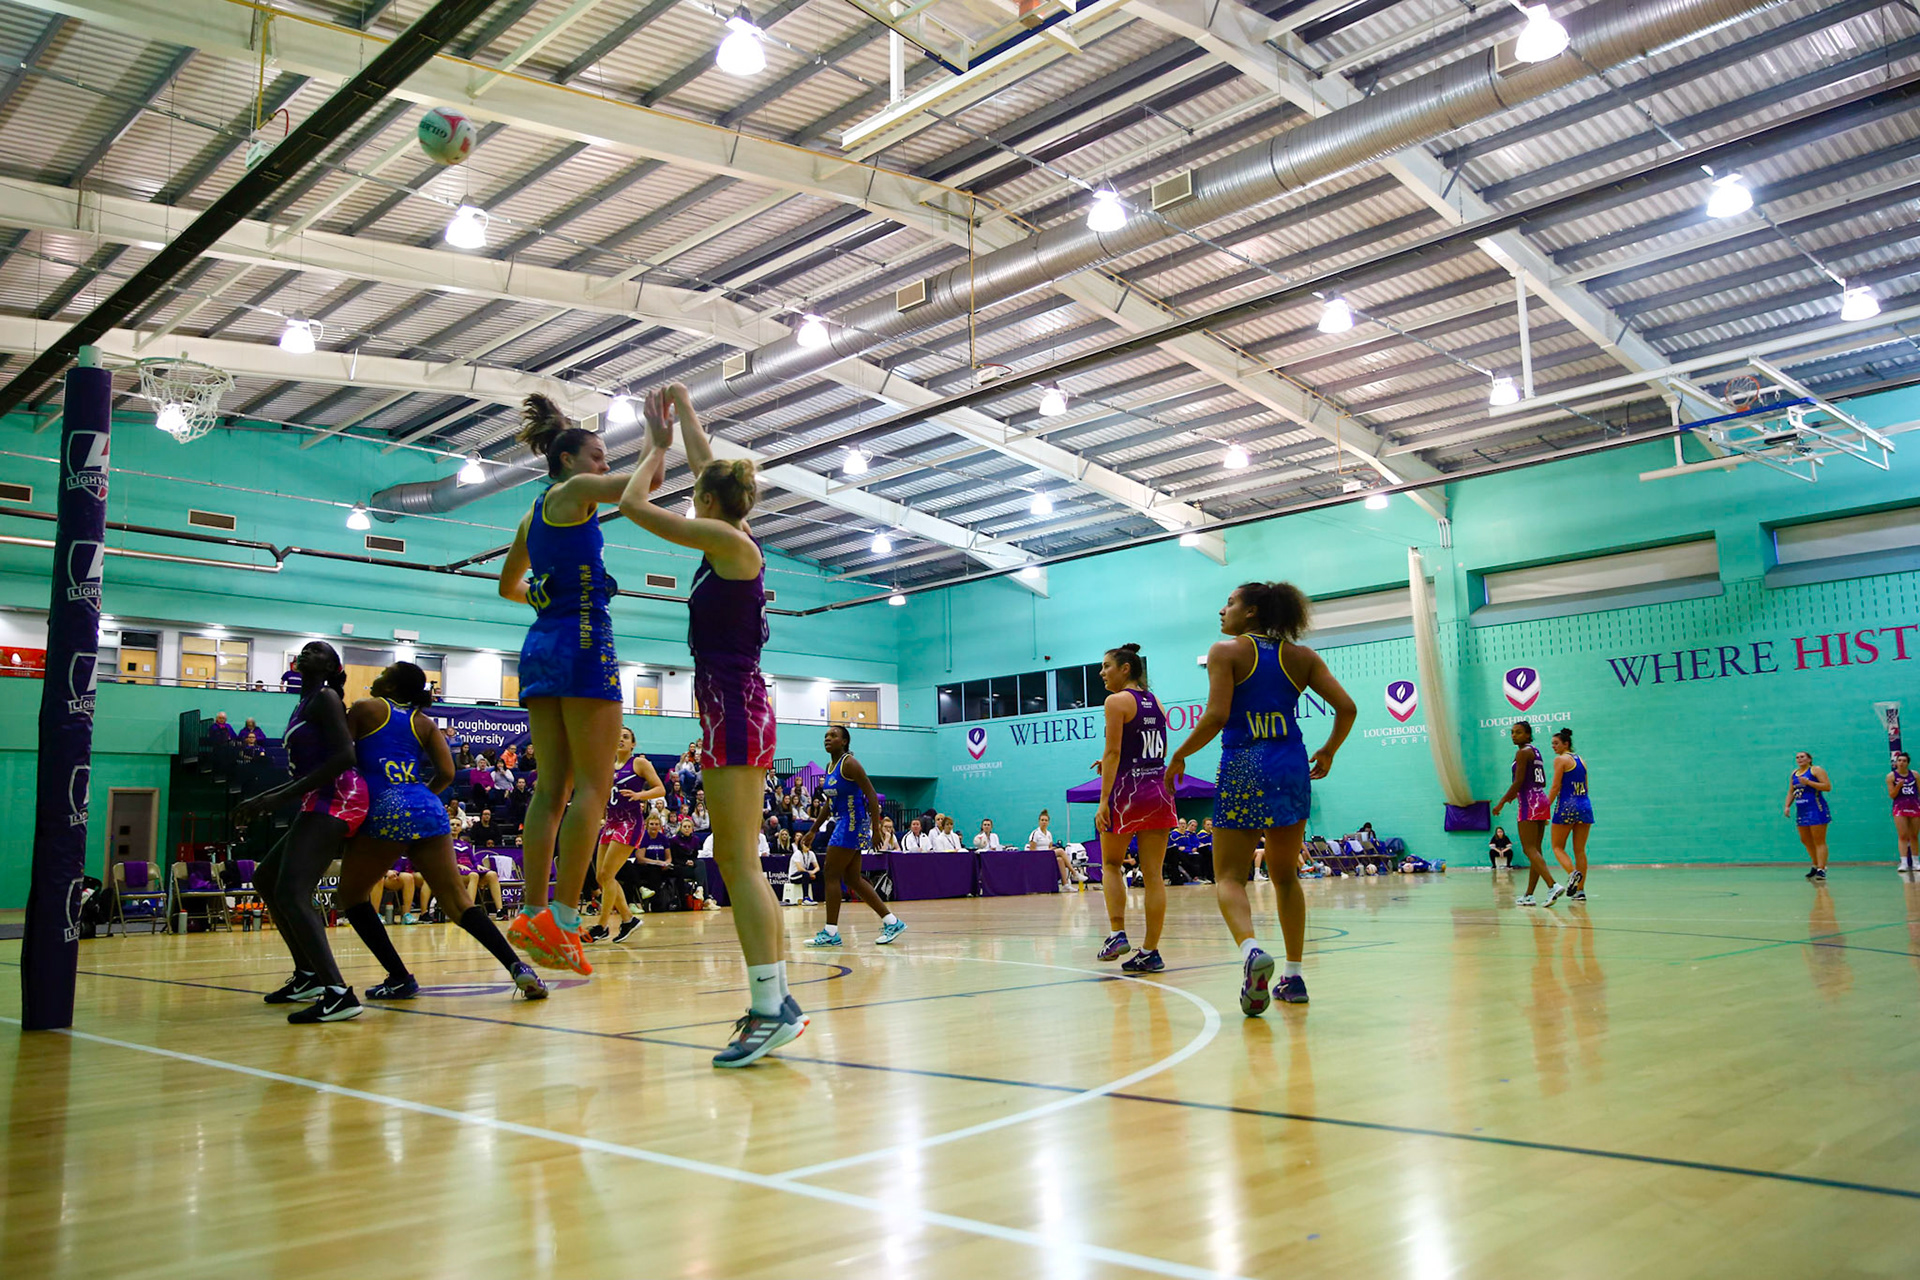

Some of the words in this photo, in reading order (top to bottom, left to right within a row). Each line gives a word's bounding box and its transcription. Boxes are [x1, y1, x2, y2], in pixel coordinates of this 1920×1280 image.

[1607, 640, 1780, 688] WHERE
[1790, 624, 1919, 671] HIST
[451, 717, 528, 735] Loughborough
[1246, 711, 1288, 740] WD
[1480, 711, 1571, 728] LOUGHBOROUGH
[456, 732, 504, 747] niversity
[1009, 715, 1097, 747] WHERE
[1363, 724, 1428, 738] LOUGHBOROU
[1500, 725, 1552, 737] SRT
[1141, 730, 1165, 759] WA
[1381, 735, 1428, 747] SPORT
[385, 760, 417, 785] GK
[610, 786, 619, 806] C
